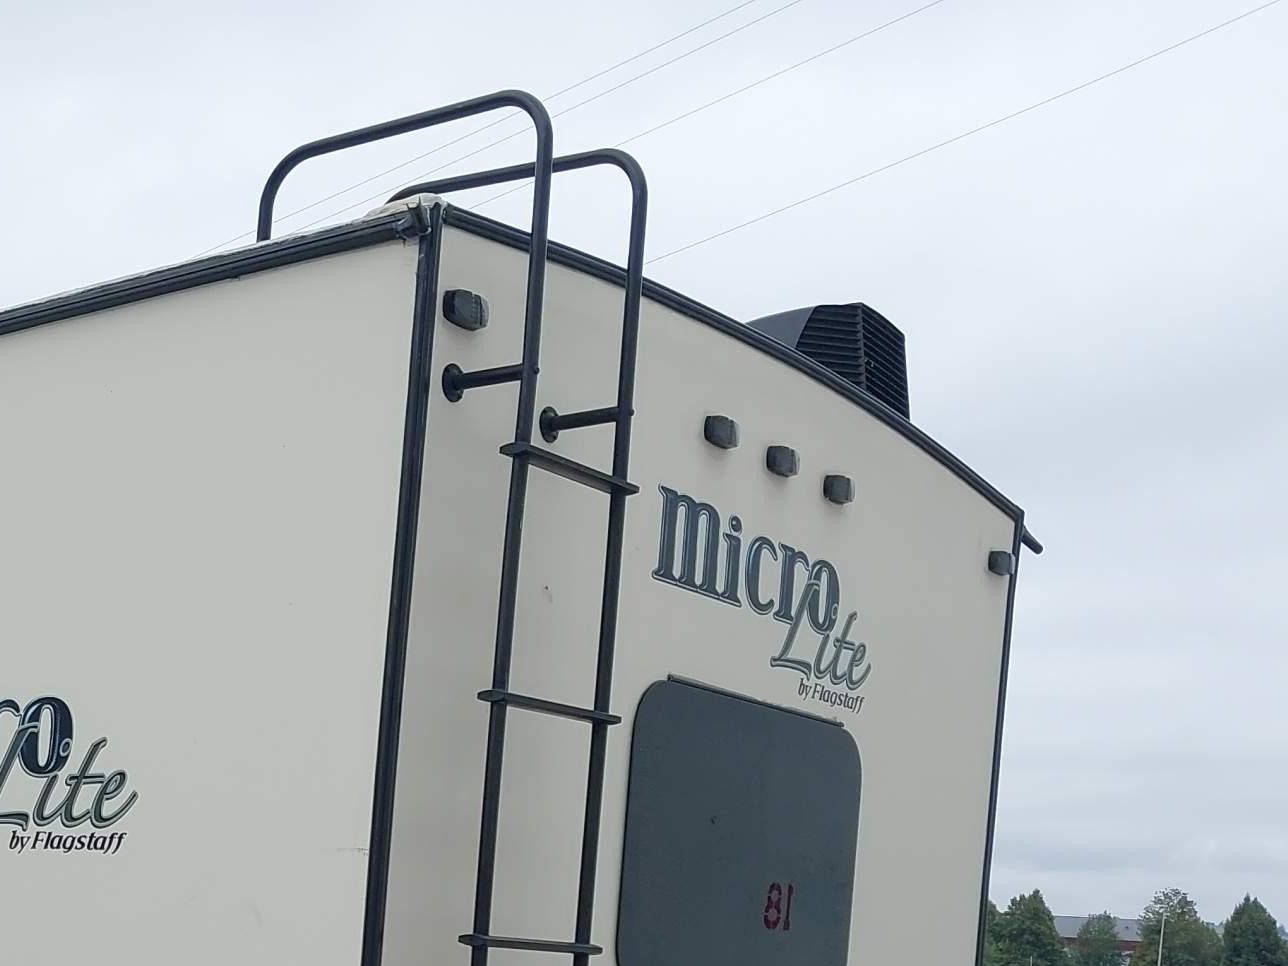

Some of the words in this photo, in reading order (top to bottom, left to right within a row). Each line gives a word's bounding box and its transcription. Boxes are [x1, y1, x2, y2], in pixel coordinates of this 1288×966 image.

[651, 483, 840, 635] micro
[770, 579, 871, 690] Lite
[798, 677, 812, 701] by
[811, 682, 865, 714] Flagstaff
[9, 830, 31, 854] by
[31, 831, 127, 854] Flagstaff
